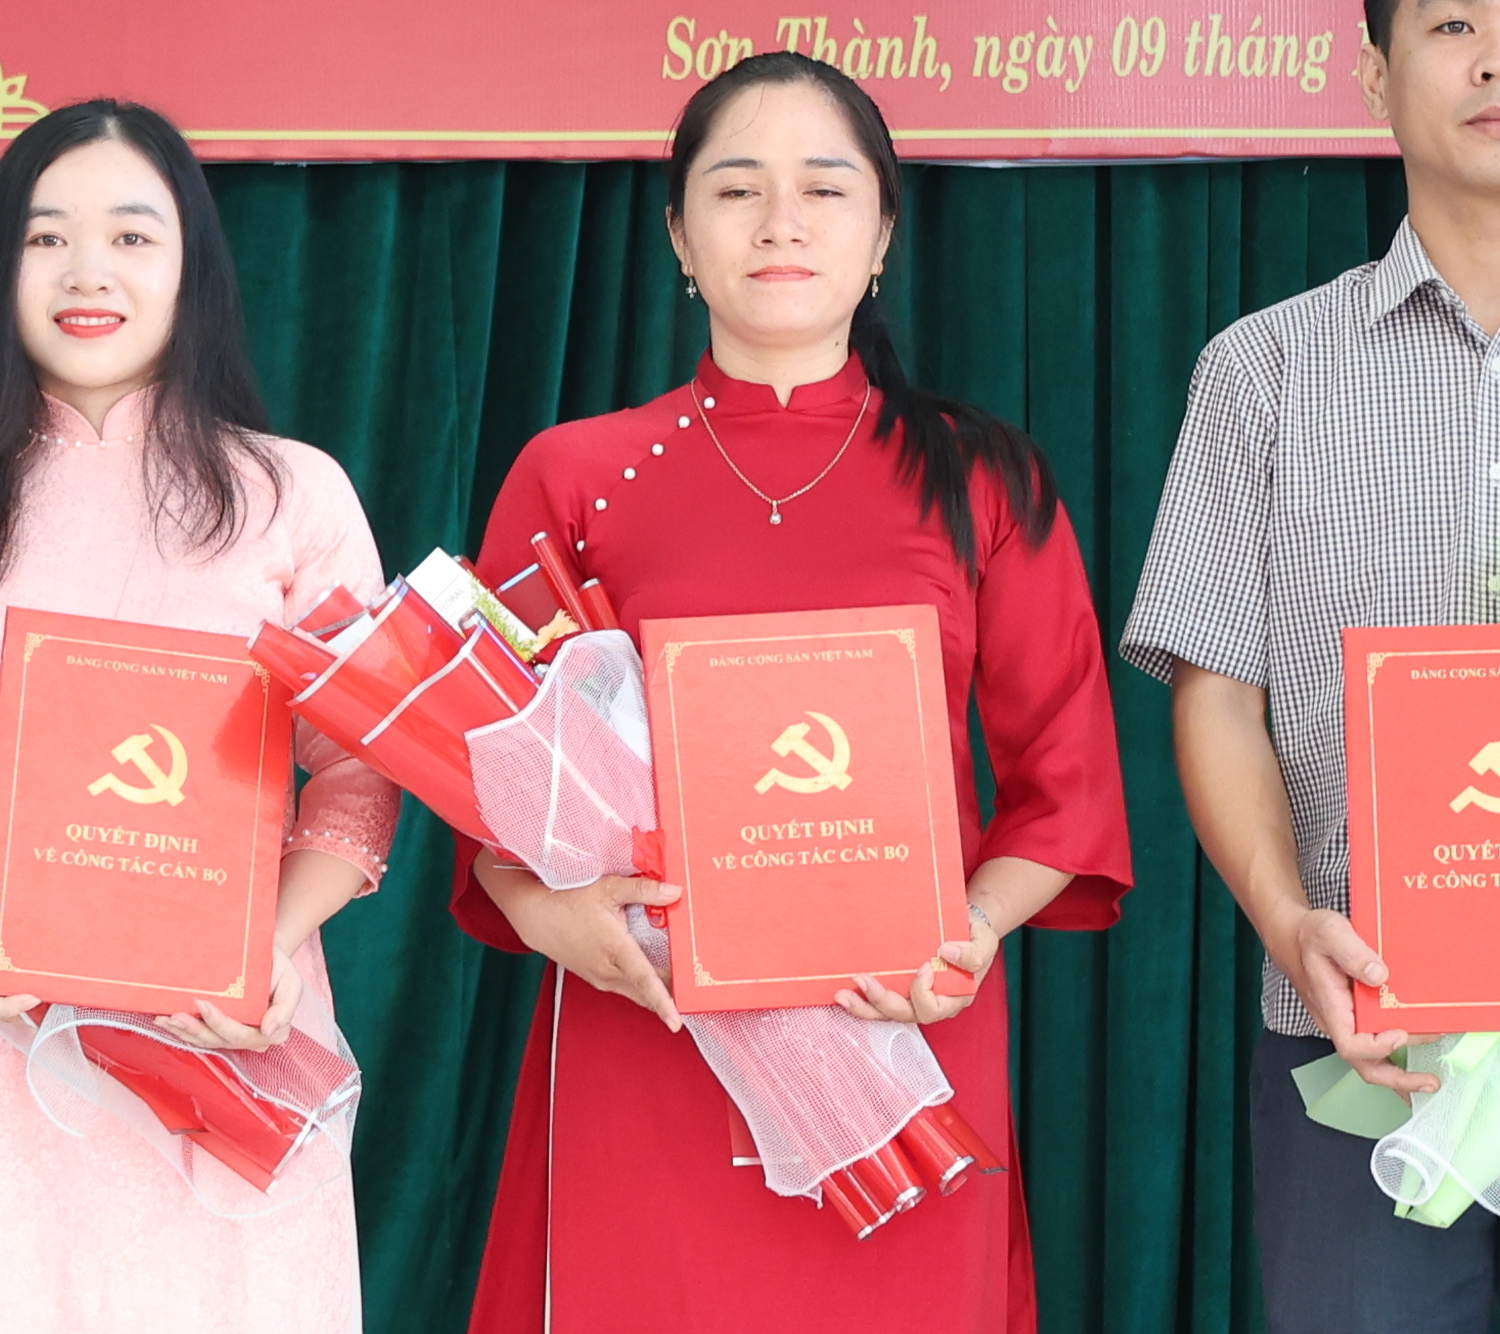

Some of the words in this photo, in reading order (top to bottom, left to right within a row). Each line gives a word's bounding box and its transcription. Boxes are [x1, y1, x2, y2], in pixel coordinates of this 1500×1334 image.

[662, 15, 753, 80] Sơn
[775, 15, 952, 93] Thành,
[973, 16, 1095, 94] ngày
[1111, 16, 1168, 78] 09
[1184, 14, 1335, 94] tháng
[438, 588, 465, 613] FLORAL
[65, 823, 140, 847] QUYẾT
[143, 832, 198, 854] ĐỊNH
[739, 818, 815, 844] QUYẾT
[819, 818, 874, 839] ĐỊNH
[60, 848, 115, 869] CÔNG
[116, 855, 156, 874] TÁC
[158, 860, 198, 879] CÁN
[201, 867, 228, 885] BỘ
[740, 849, 794, 868] CÔNG
[797, 846, 836, 865] TÁC
[839, 844, 879, 862] CÁN
[883, 843, 910, 862] BỘ
[1432, 870, 1487, 888] CÔNG
